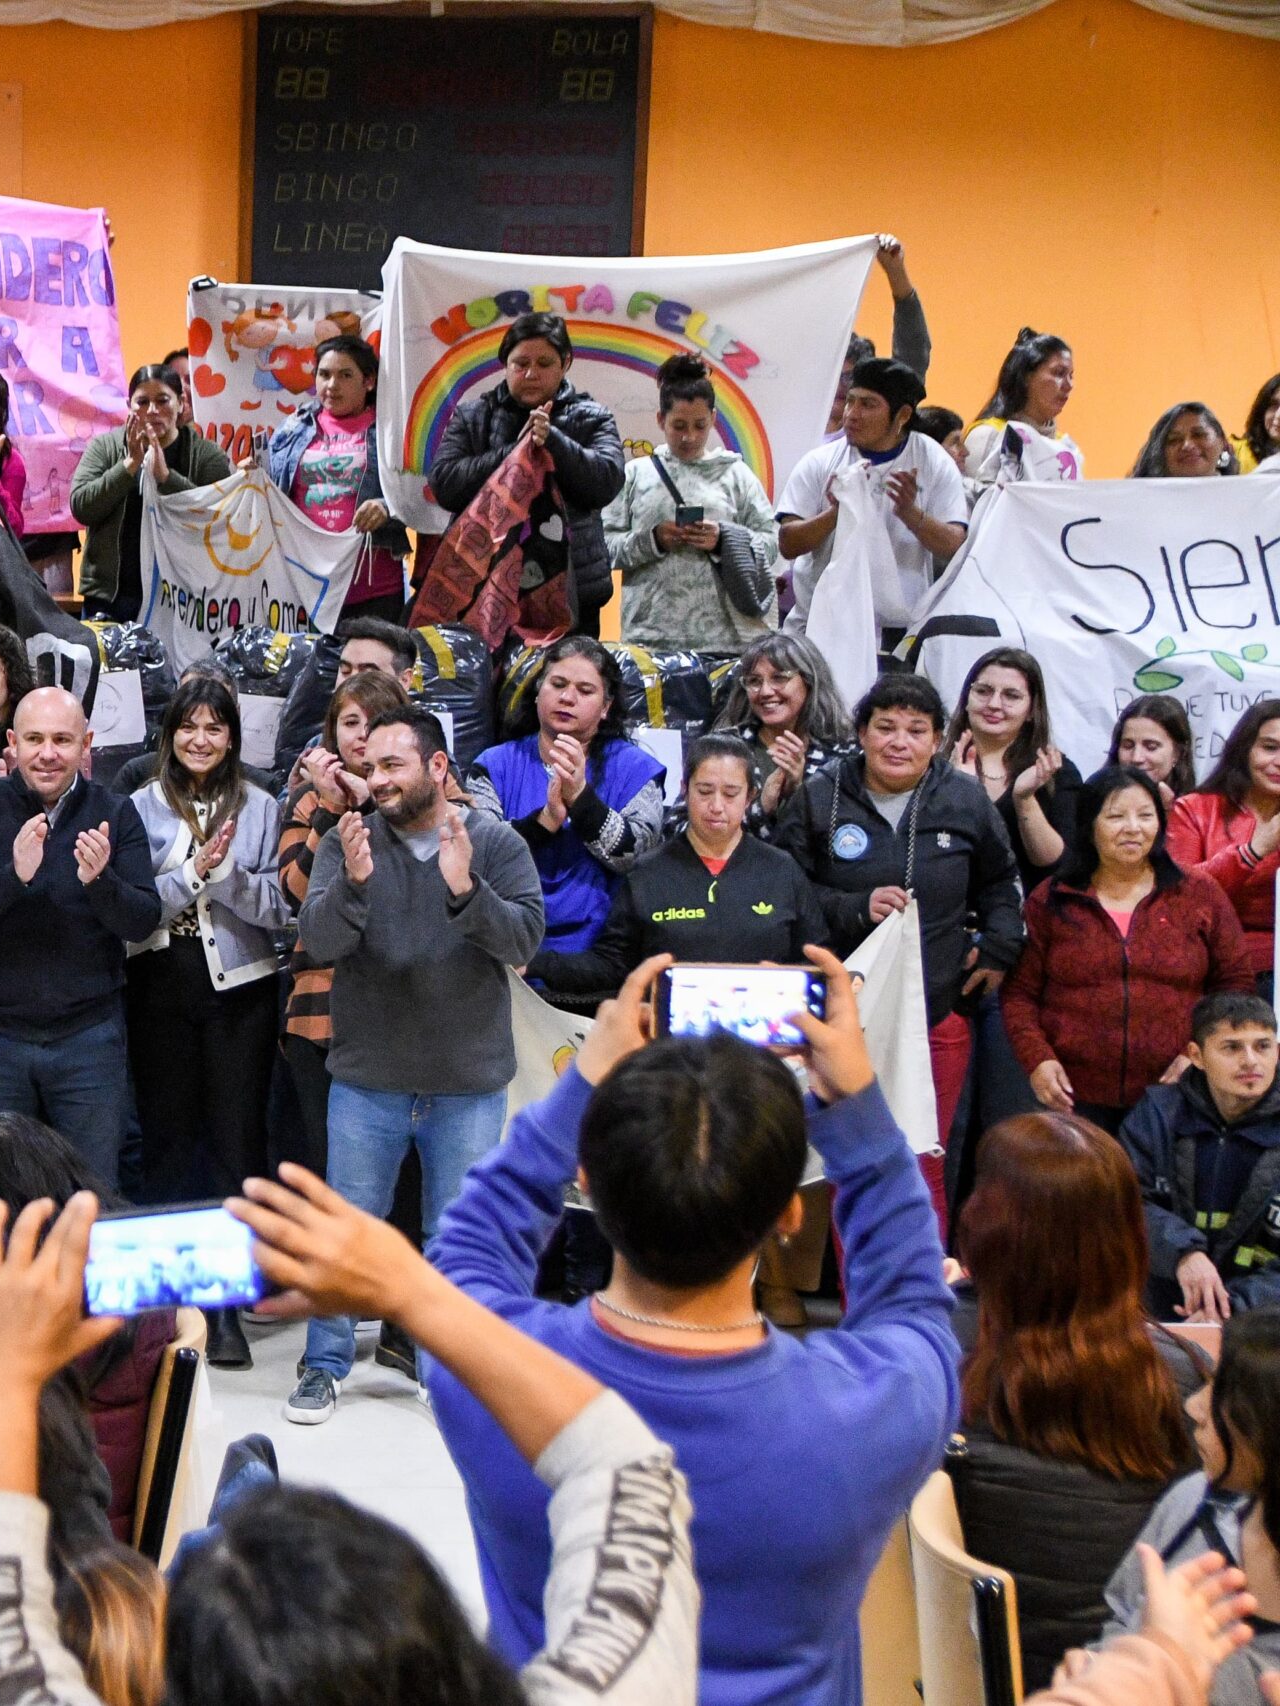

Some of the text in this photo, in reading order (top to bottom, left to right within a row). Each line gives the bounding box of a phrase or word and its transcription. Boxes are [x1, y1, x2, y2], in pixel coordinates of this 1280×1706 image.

[551, 28, 629, 56] BOLA
[274, 172, 399, 202] BINGO
[272, 222, 389, 253] LINEA
[61, 325, 100, 377] A
[652, 905, 706, 923] adidas
